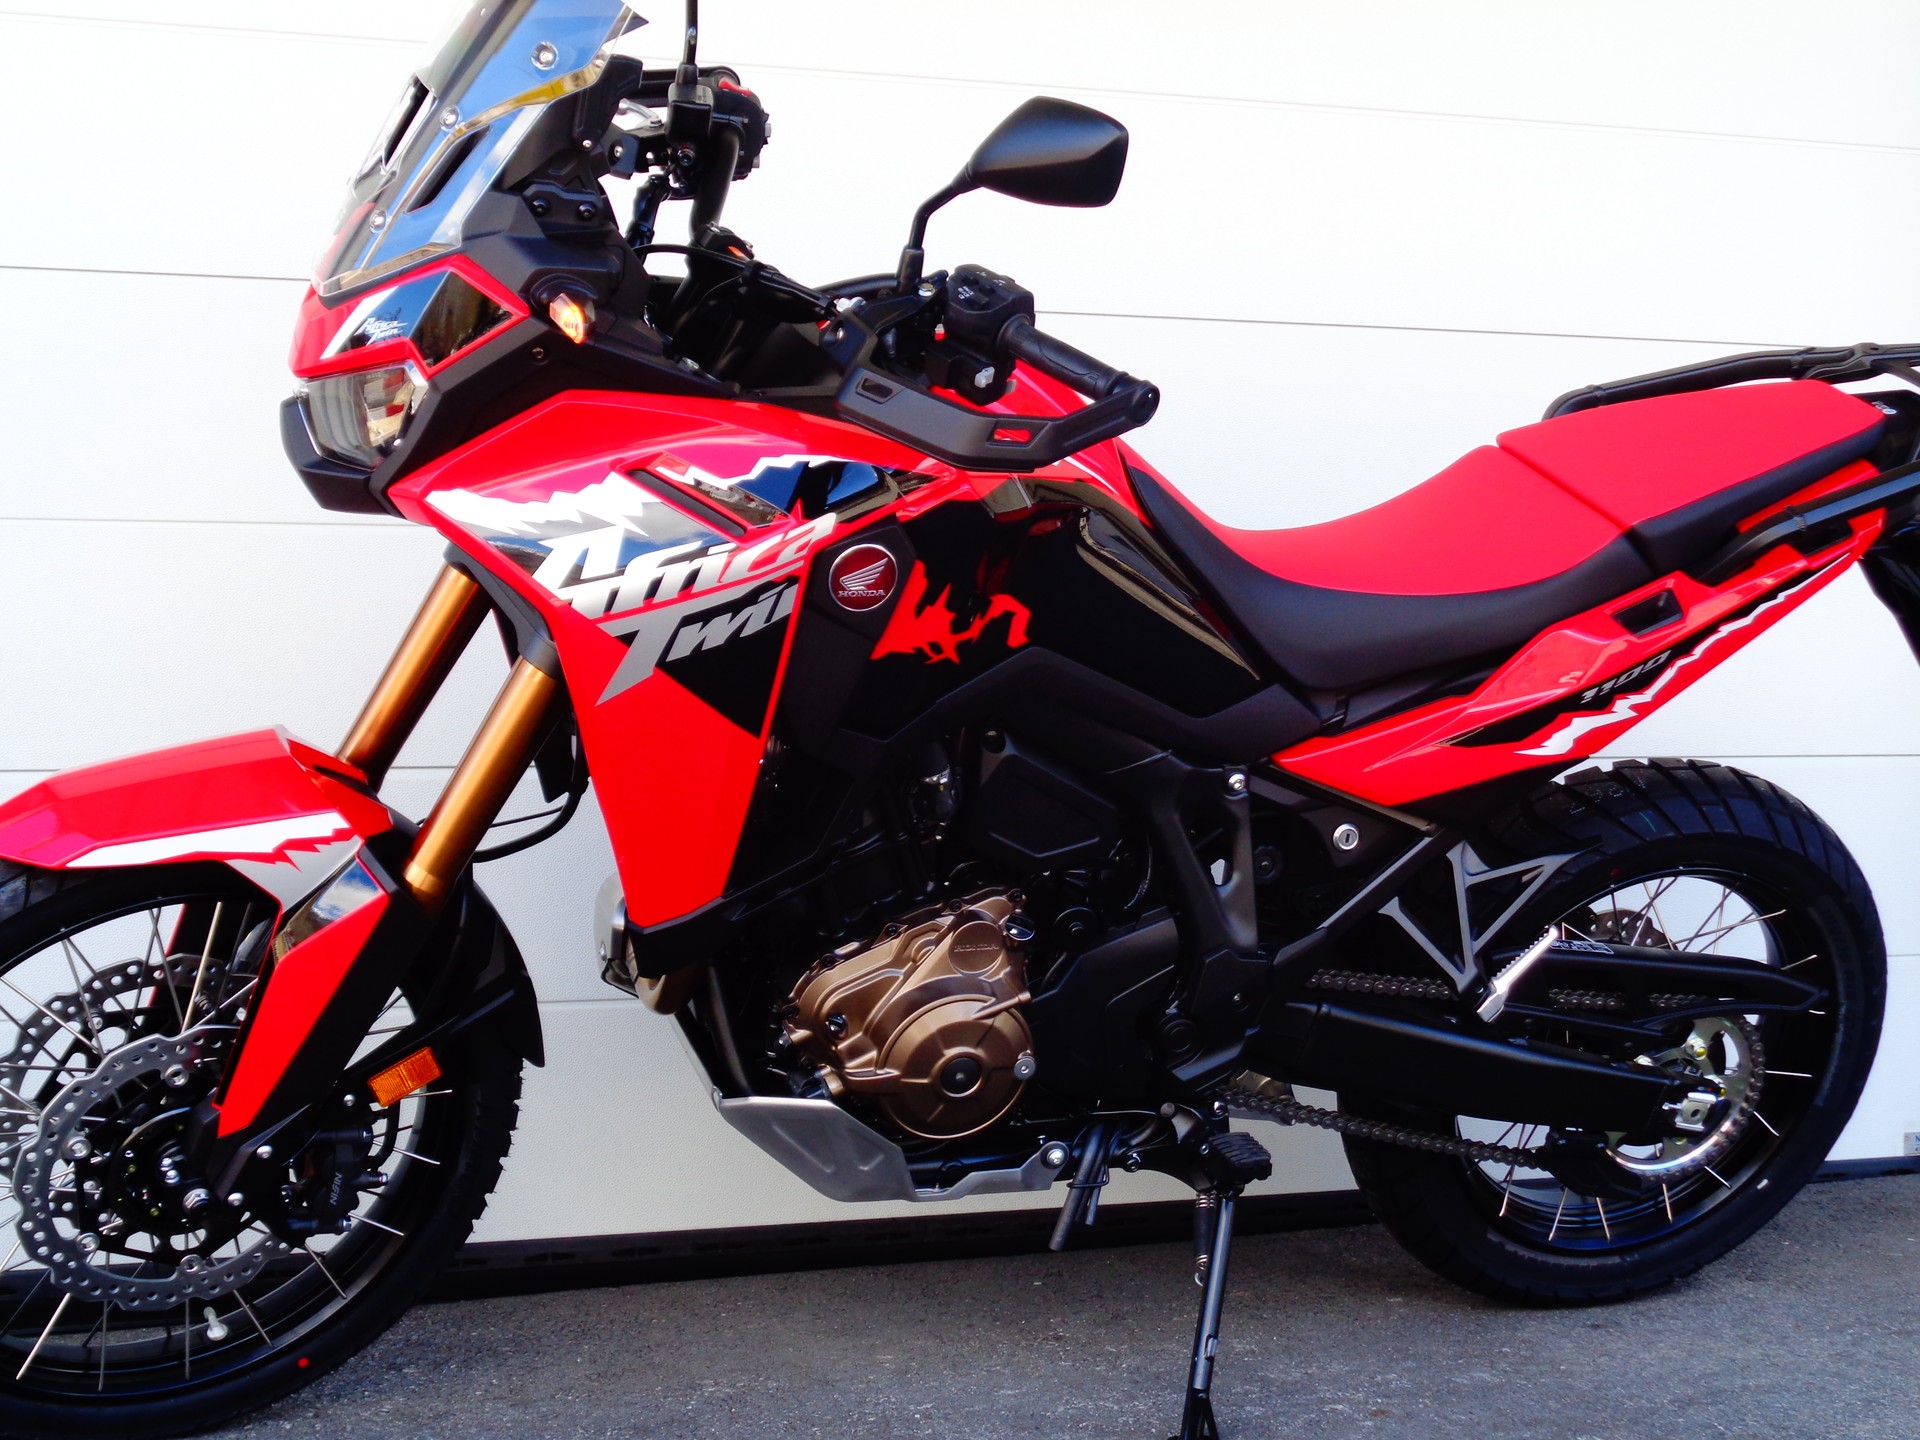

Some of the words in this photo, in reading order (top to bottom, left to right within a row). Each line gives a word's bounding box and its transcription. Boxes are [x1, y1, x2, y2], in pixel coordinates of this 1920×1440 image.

[353, 317, 408, 336] Africa
[532, 512, 836, 620] Africa
[837, 589, 886, 598] HONDA
[1580, 650, 1671, 704] 1100
